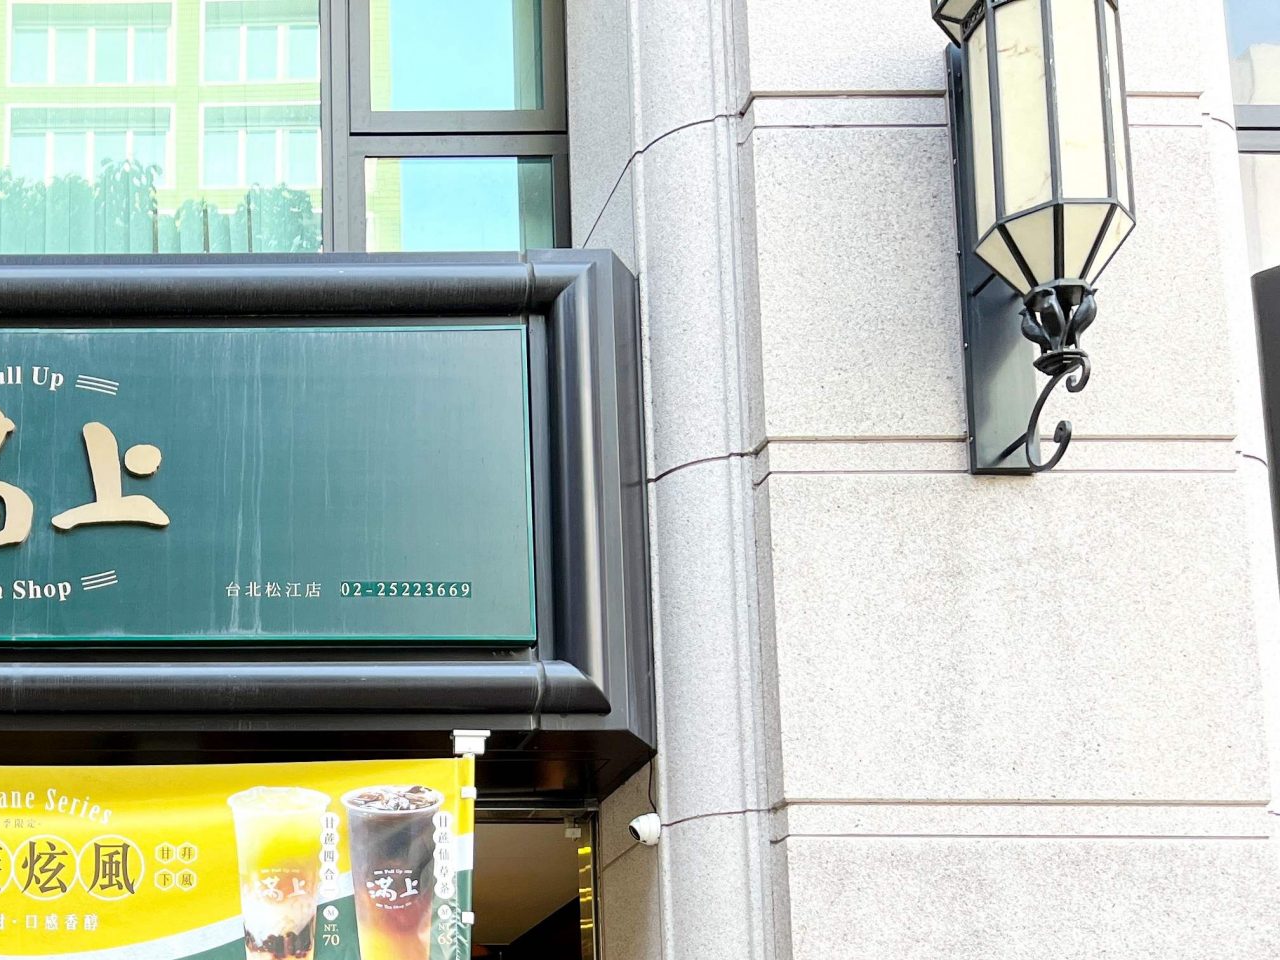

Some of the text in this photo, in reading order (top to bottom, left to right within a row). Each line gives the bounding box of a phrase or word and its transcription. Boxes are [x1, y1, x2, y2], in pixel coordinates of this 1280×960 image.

[32, 366, 64, 391] Up
[12, 577, 72, 601] Shop
[225, 581, 470, 598] 台北松江店 02-25223669
[44, 788, 112, 825] Series
[322, 934, 339, 946] 70
